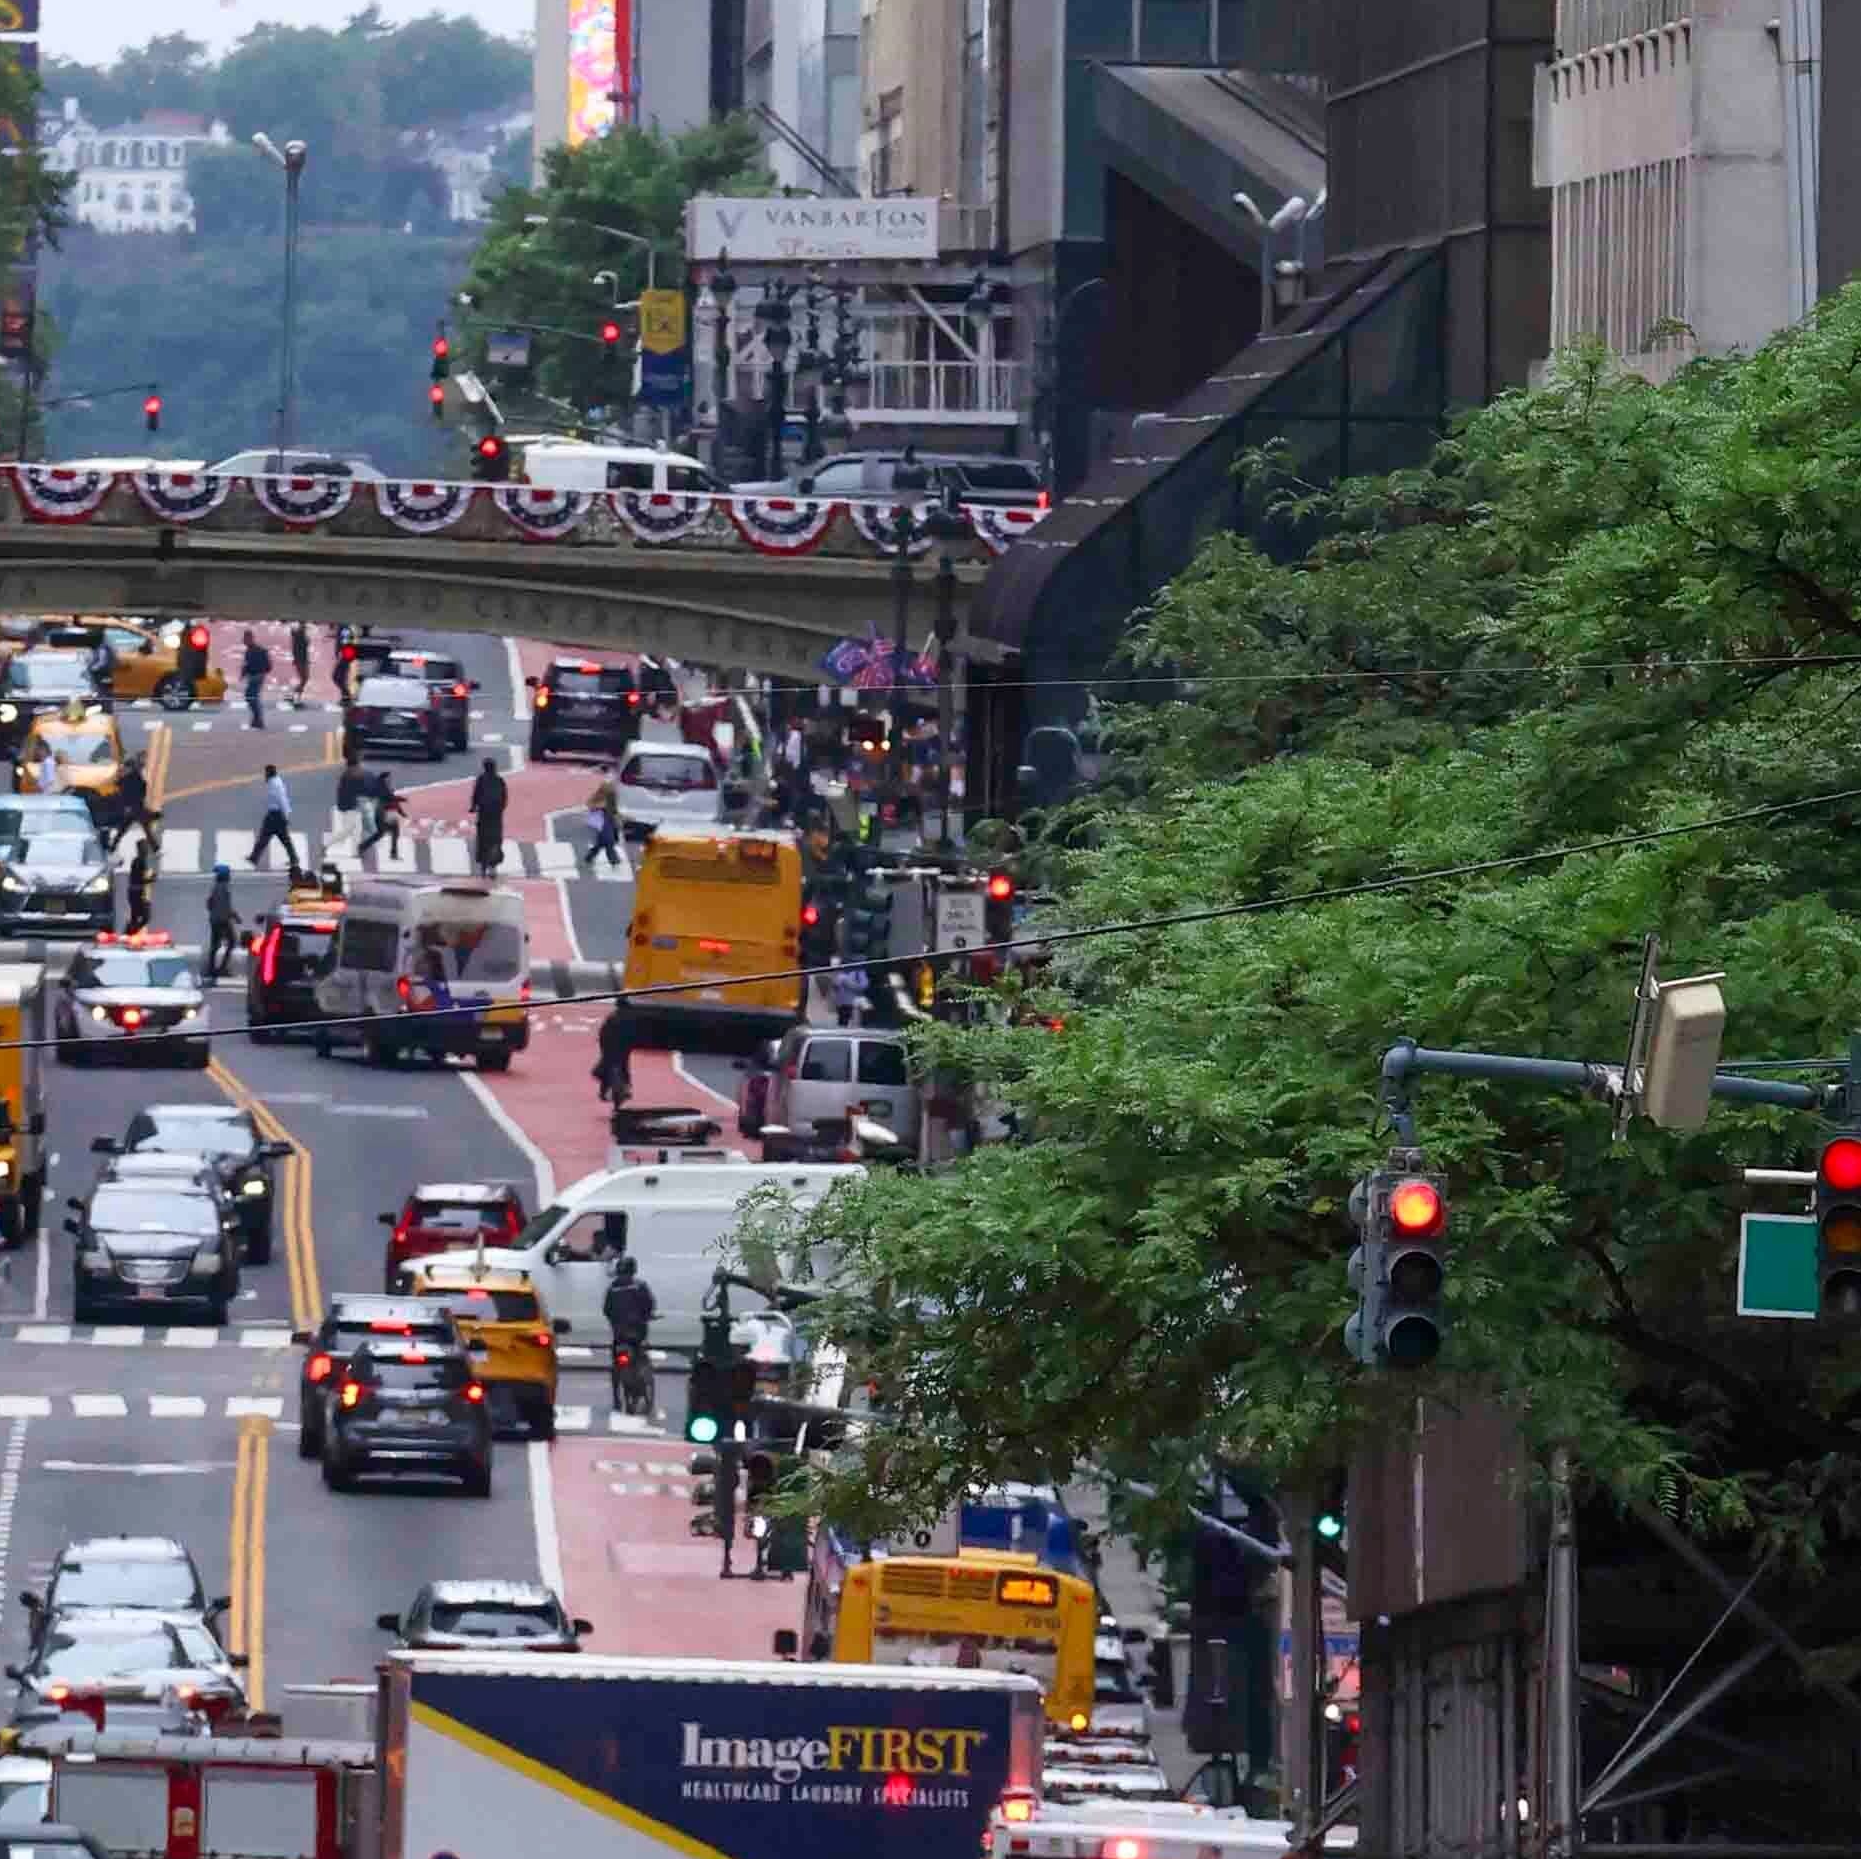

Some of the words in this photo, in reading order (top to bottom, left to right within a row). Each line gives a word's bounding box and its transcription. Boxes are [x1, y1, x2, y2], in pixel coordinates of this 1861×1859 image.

[765, 206, 926, 229] VANBARTON
[680, 1721, 980, 1783] ImageFIRST
[681, 1781, 781, 1802] HEALTHCARE
[791, 1784, 863, 1803] LAUNDRY
